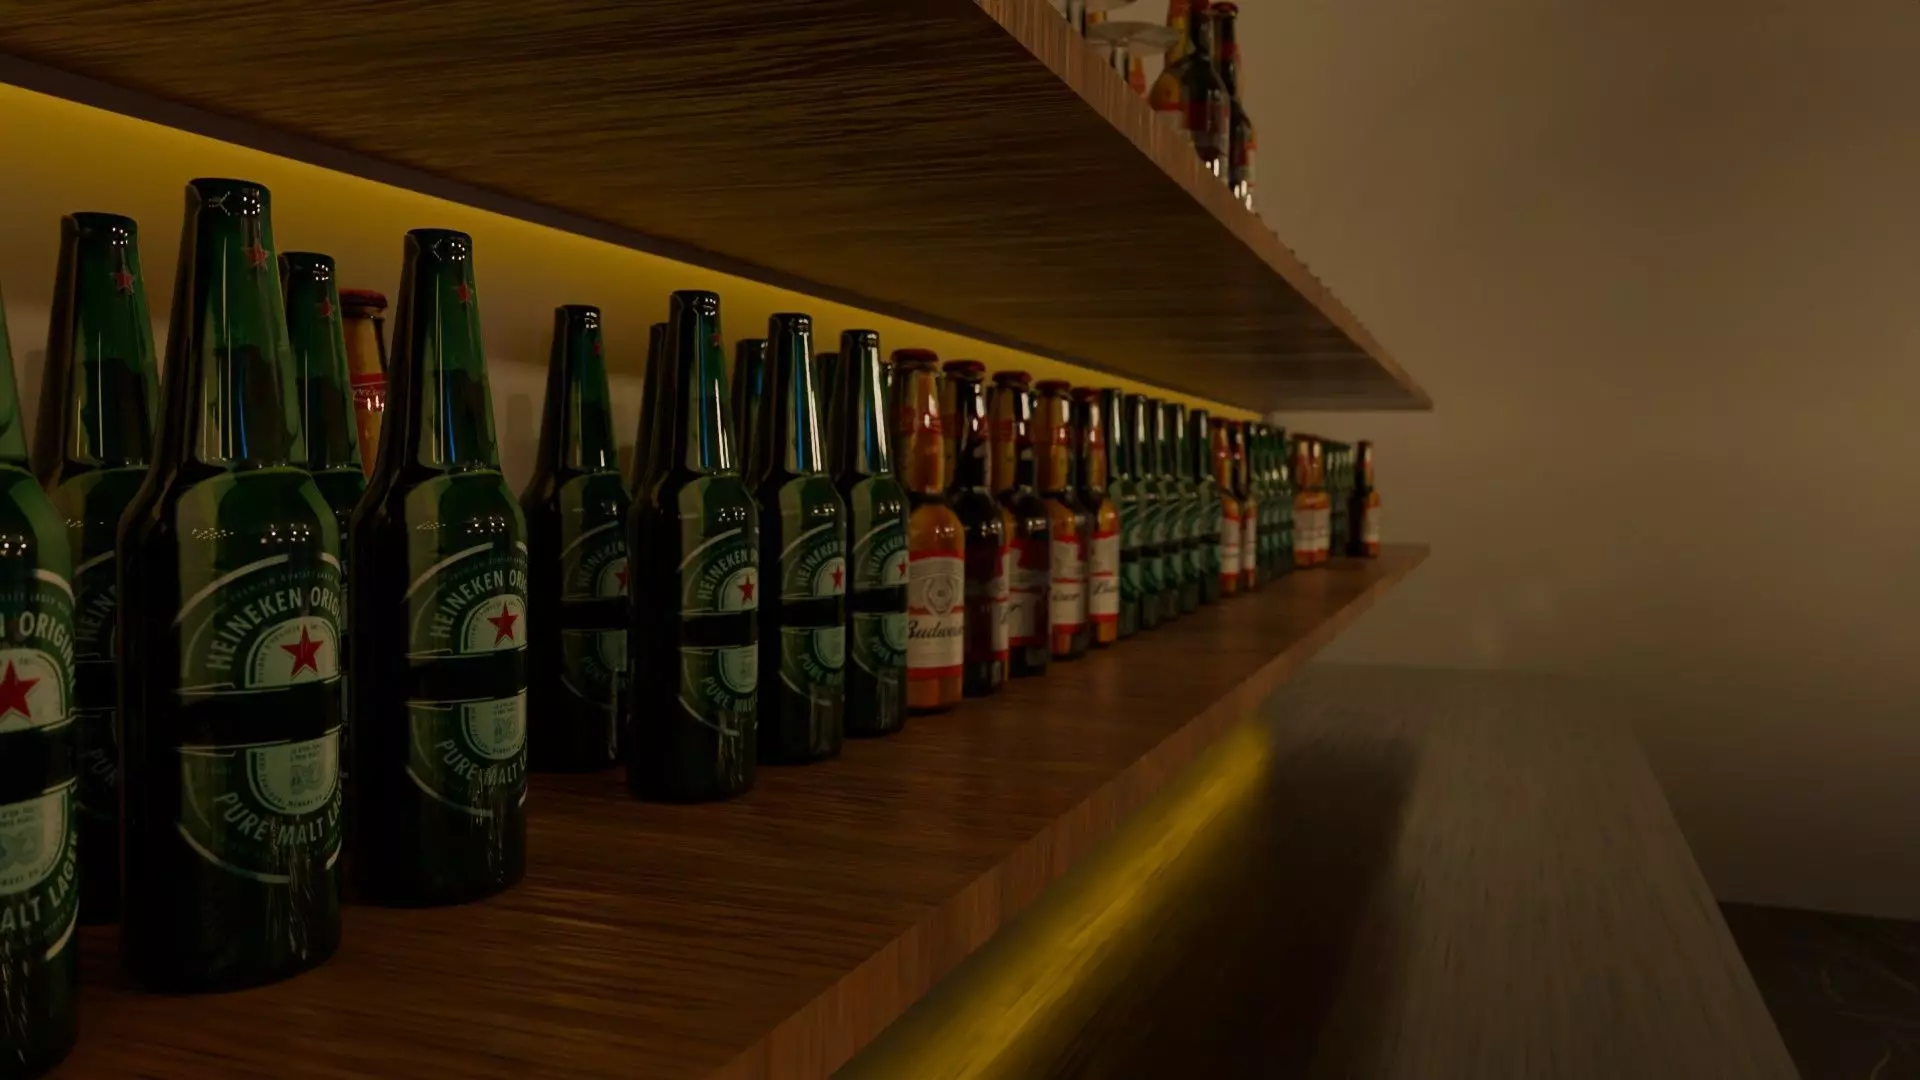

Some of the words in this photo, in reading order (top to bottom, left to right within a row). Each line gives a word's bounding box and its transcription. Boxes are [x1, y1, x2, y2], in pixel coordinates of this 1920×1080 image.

[205, 586, 302, 671] HEINEKEN
[428, 568, 504, 638] HEINEKEN
[435, 739, 480, 780] PURE
[213, 791, 270, 842] PURE
[278, 815, 324, 846] MALT
[0, 896, 41, 933] ALT
